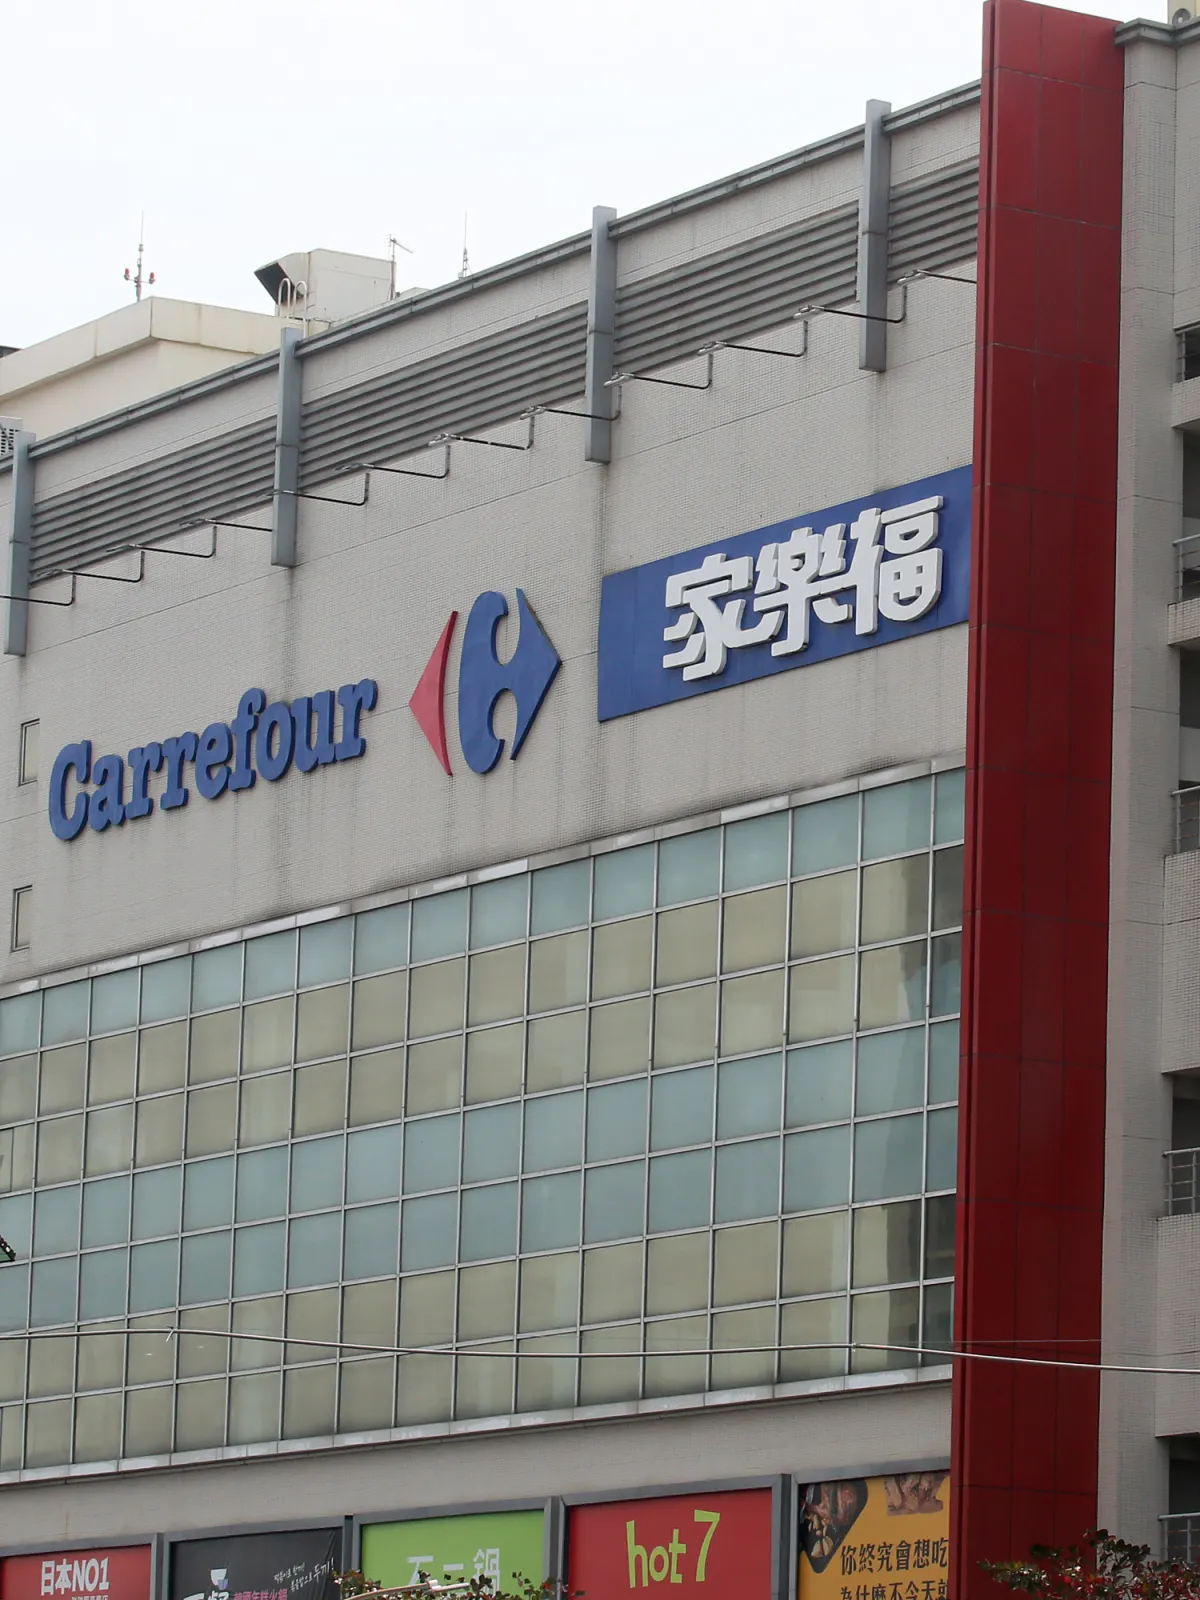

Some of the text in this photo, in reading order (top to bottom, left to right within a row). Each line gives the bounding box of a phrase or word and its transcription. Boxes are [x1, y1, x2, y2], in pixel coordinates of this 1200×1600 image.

[662, 495, 944, 682] 家樂福
[48, 678, 378, 841] Carrefour
[626, 1509, 720, 1588] hot 7
[841, 1537, 949, 1576] 你終究會想吃
